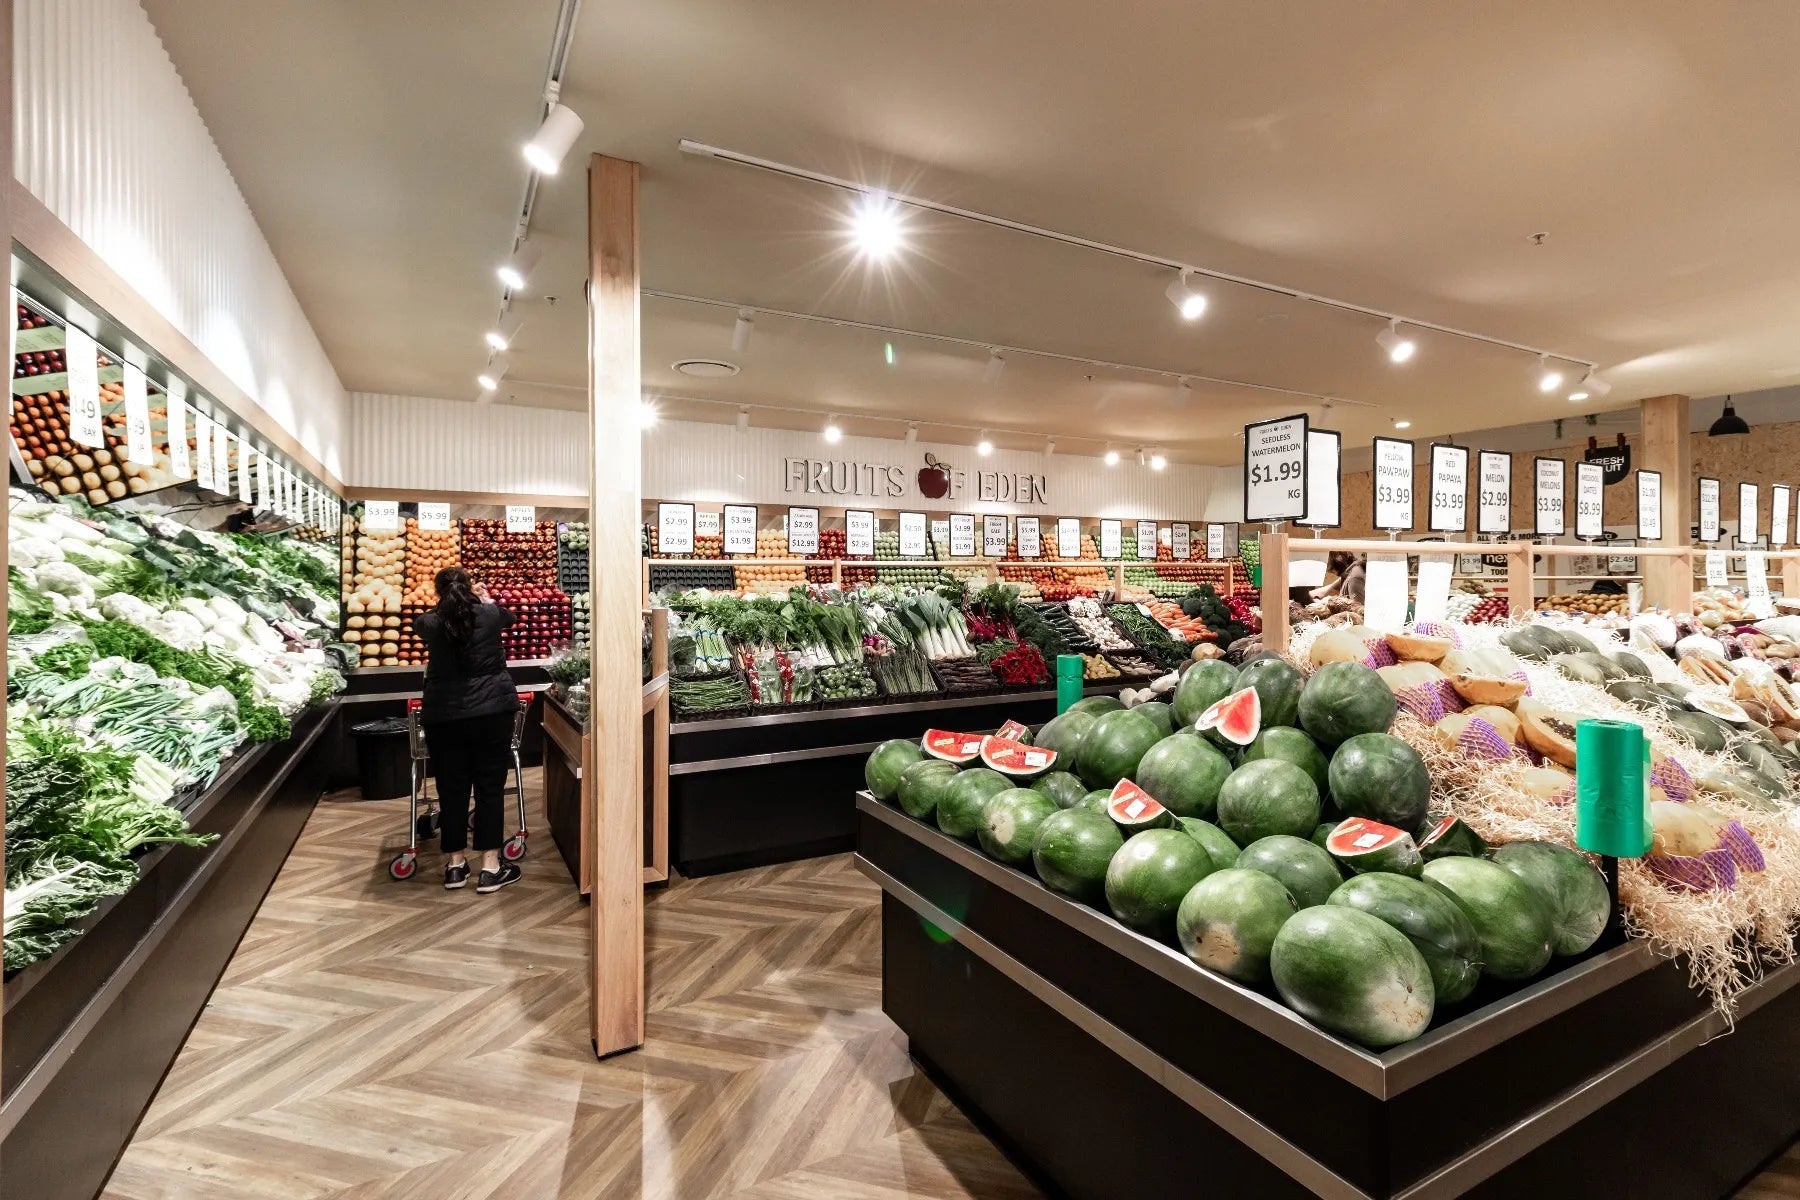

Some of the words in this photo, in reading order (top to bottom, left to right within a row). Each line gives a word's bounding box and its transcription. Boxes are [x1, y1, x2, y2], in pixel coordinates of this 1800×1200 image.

[1261, 433, 1291, 445] SEEDLESS
[1251, 443, 1301, 457] WATERMELON
[1251, 461, 1301, 487] $1.99
[1378, 465, 1410, 478] PAWPAW
[785, 457, 905, 498] FRUITS
[978, 469, 1048, 504] EDEN
[1438, 472, 1462, 484] PAPAYA
[1485, 473, 1505, 483] MELON
[1540, 480, 1561, 490] MELONS
[1288, 489, 1301, 499] KG
[1378, 484, 1410, 504] $3.99
[1481, 489, 1508, 508] $2.99
[1434, 490, 1463, 510] $3.99
[1538, 496, 1562, 513] $3.99
[368, 507, 395, 516] $3.99
[1579, 500, 1601, 517] $8.99
[421, 511, 447, 521] $5.99
[731, 516, 752, 524] $3.99
[1400, 512, 1409, 520] KG
[665, 537, 687, 545] $2.99
[730, 537, 751, 545] $1.99
[985, 537, 1006, 546] $3.99
[1462, 557, 1481, 565] $3.99
